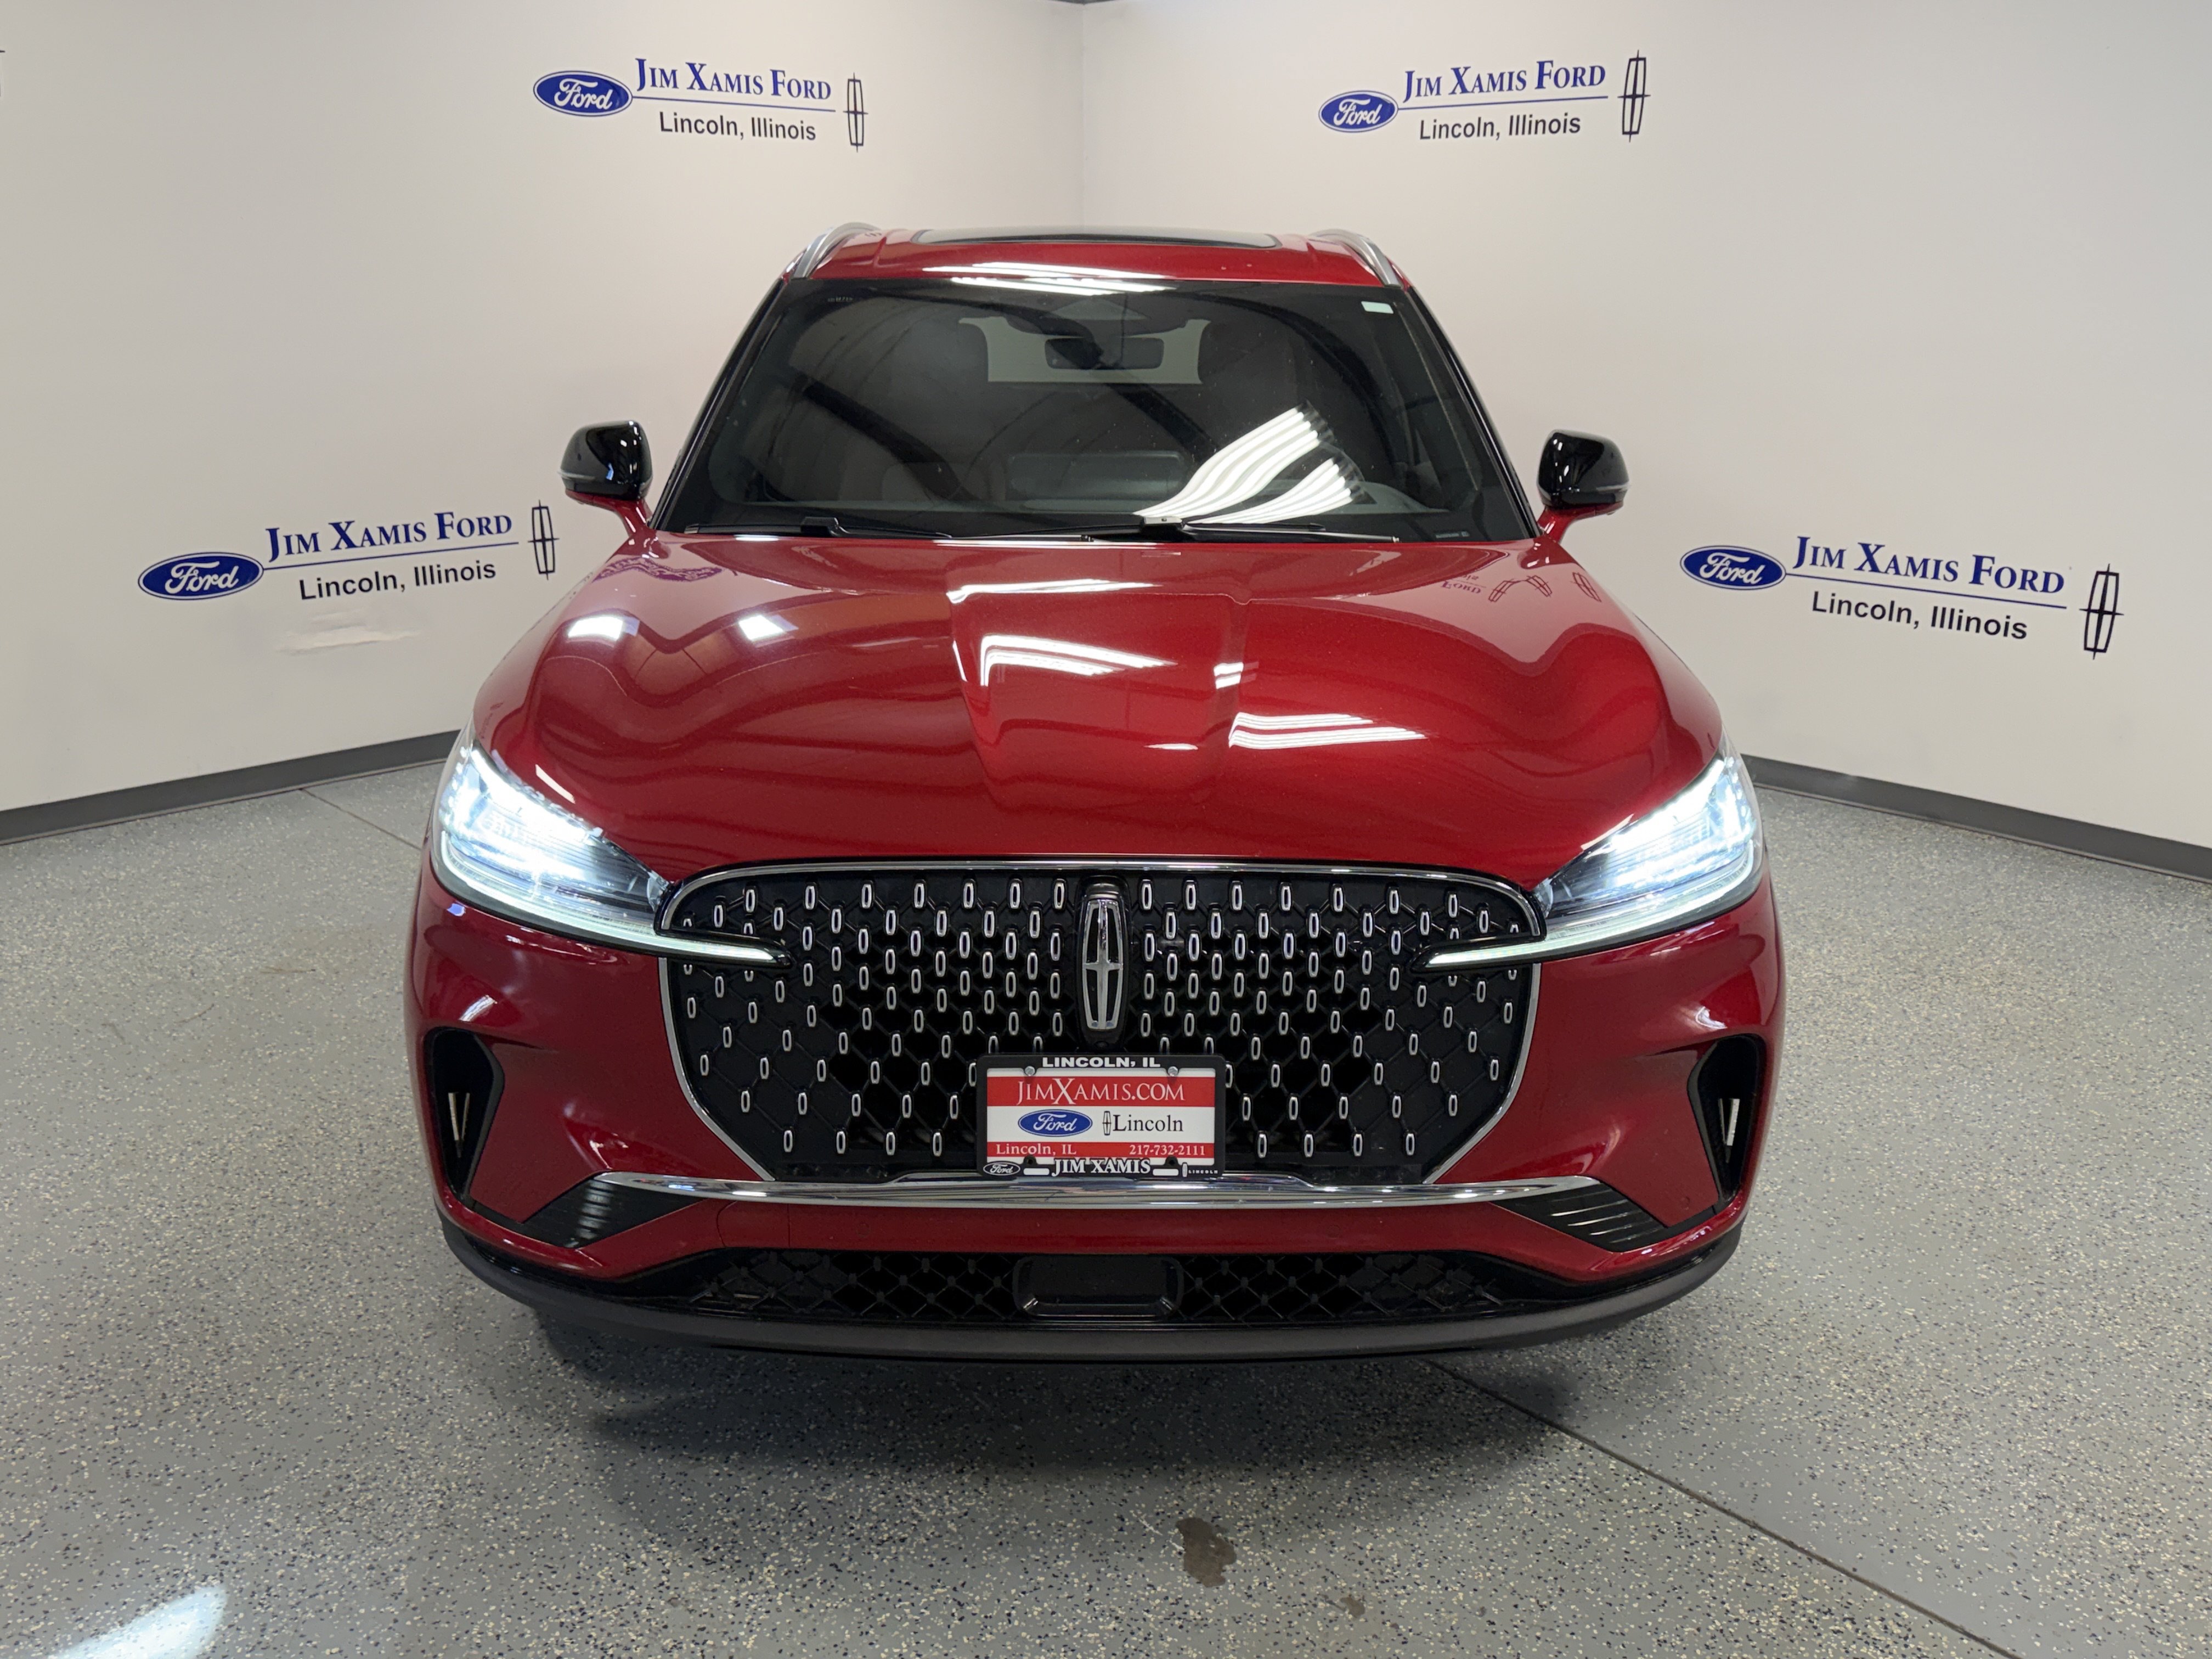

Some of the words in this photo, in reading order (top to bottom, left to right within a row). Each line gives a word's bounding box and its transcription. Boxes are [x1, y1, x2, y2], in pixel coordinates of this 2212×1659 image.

[635, 58, 679, 92] JIM
[685, 62, 764, 95] XAMIS
[770, 69, 831, 100] FORD
[1403, 70, 1442, 103] JIM
[1449, 66, 1527, 95] XAMIS
[1534, 60, 1606, 89] FORD
[554, 77, 613, 111] Ford
[659, 111, 743, 140] Lincoln,
[751, 117, 816, 140] Illinois
[1333, 98, 1381, 127] Ford
[1420, 116, 1500, 140] Lincoln,
[1508, 112, 1581, 136] Illinois
[265, 527, 320, 563] JIM
[328, 520, 427, 551] XAMIS
[434, 511, 512, 540] FORD
[165, 560, 239, 595] Ford
[1699, 551, 1765, 586] Ford
[1792, 535, 1847, 569] JIM
[1853, 541, 1960, 583] XAMIS
[1968, 554, 2065, 594] FORD
[299, 570, 405, 600] Lincoln,
[414, 560, 496, 586] Illinois
[1812, 590, 1920, 630] Lincoln,
[1930, 605, 2029, 640] Illinois
[1042, 1057, 1136, 1068] LINCOLN,
[1142, 1057, 1161, 1068] IL
[1033, 1113, 1076, 1132] Ford
[1113, 1114, 1183, 1132] Lincoln
[996, 1143, 1056, 1156] Lincoln,
[1062, 1144, 1076, 1155] IL
[1129, 1144, 1205, 1156] 217-732-2111
[990, 1164, 1013, 1174] Ford
[1052, 1159, 1086, 1177] JIM
[1090, 1158, 1151, 1174] XAMIS
